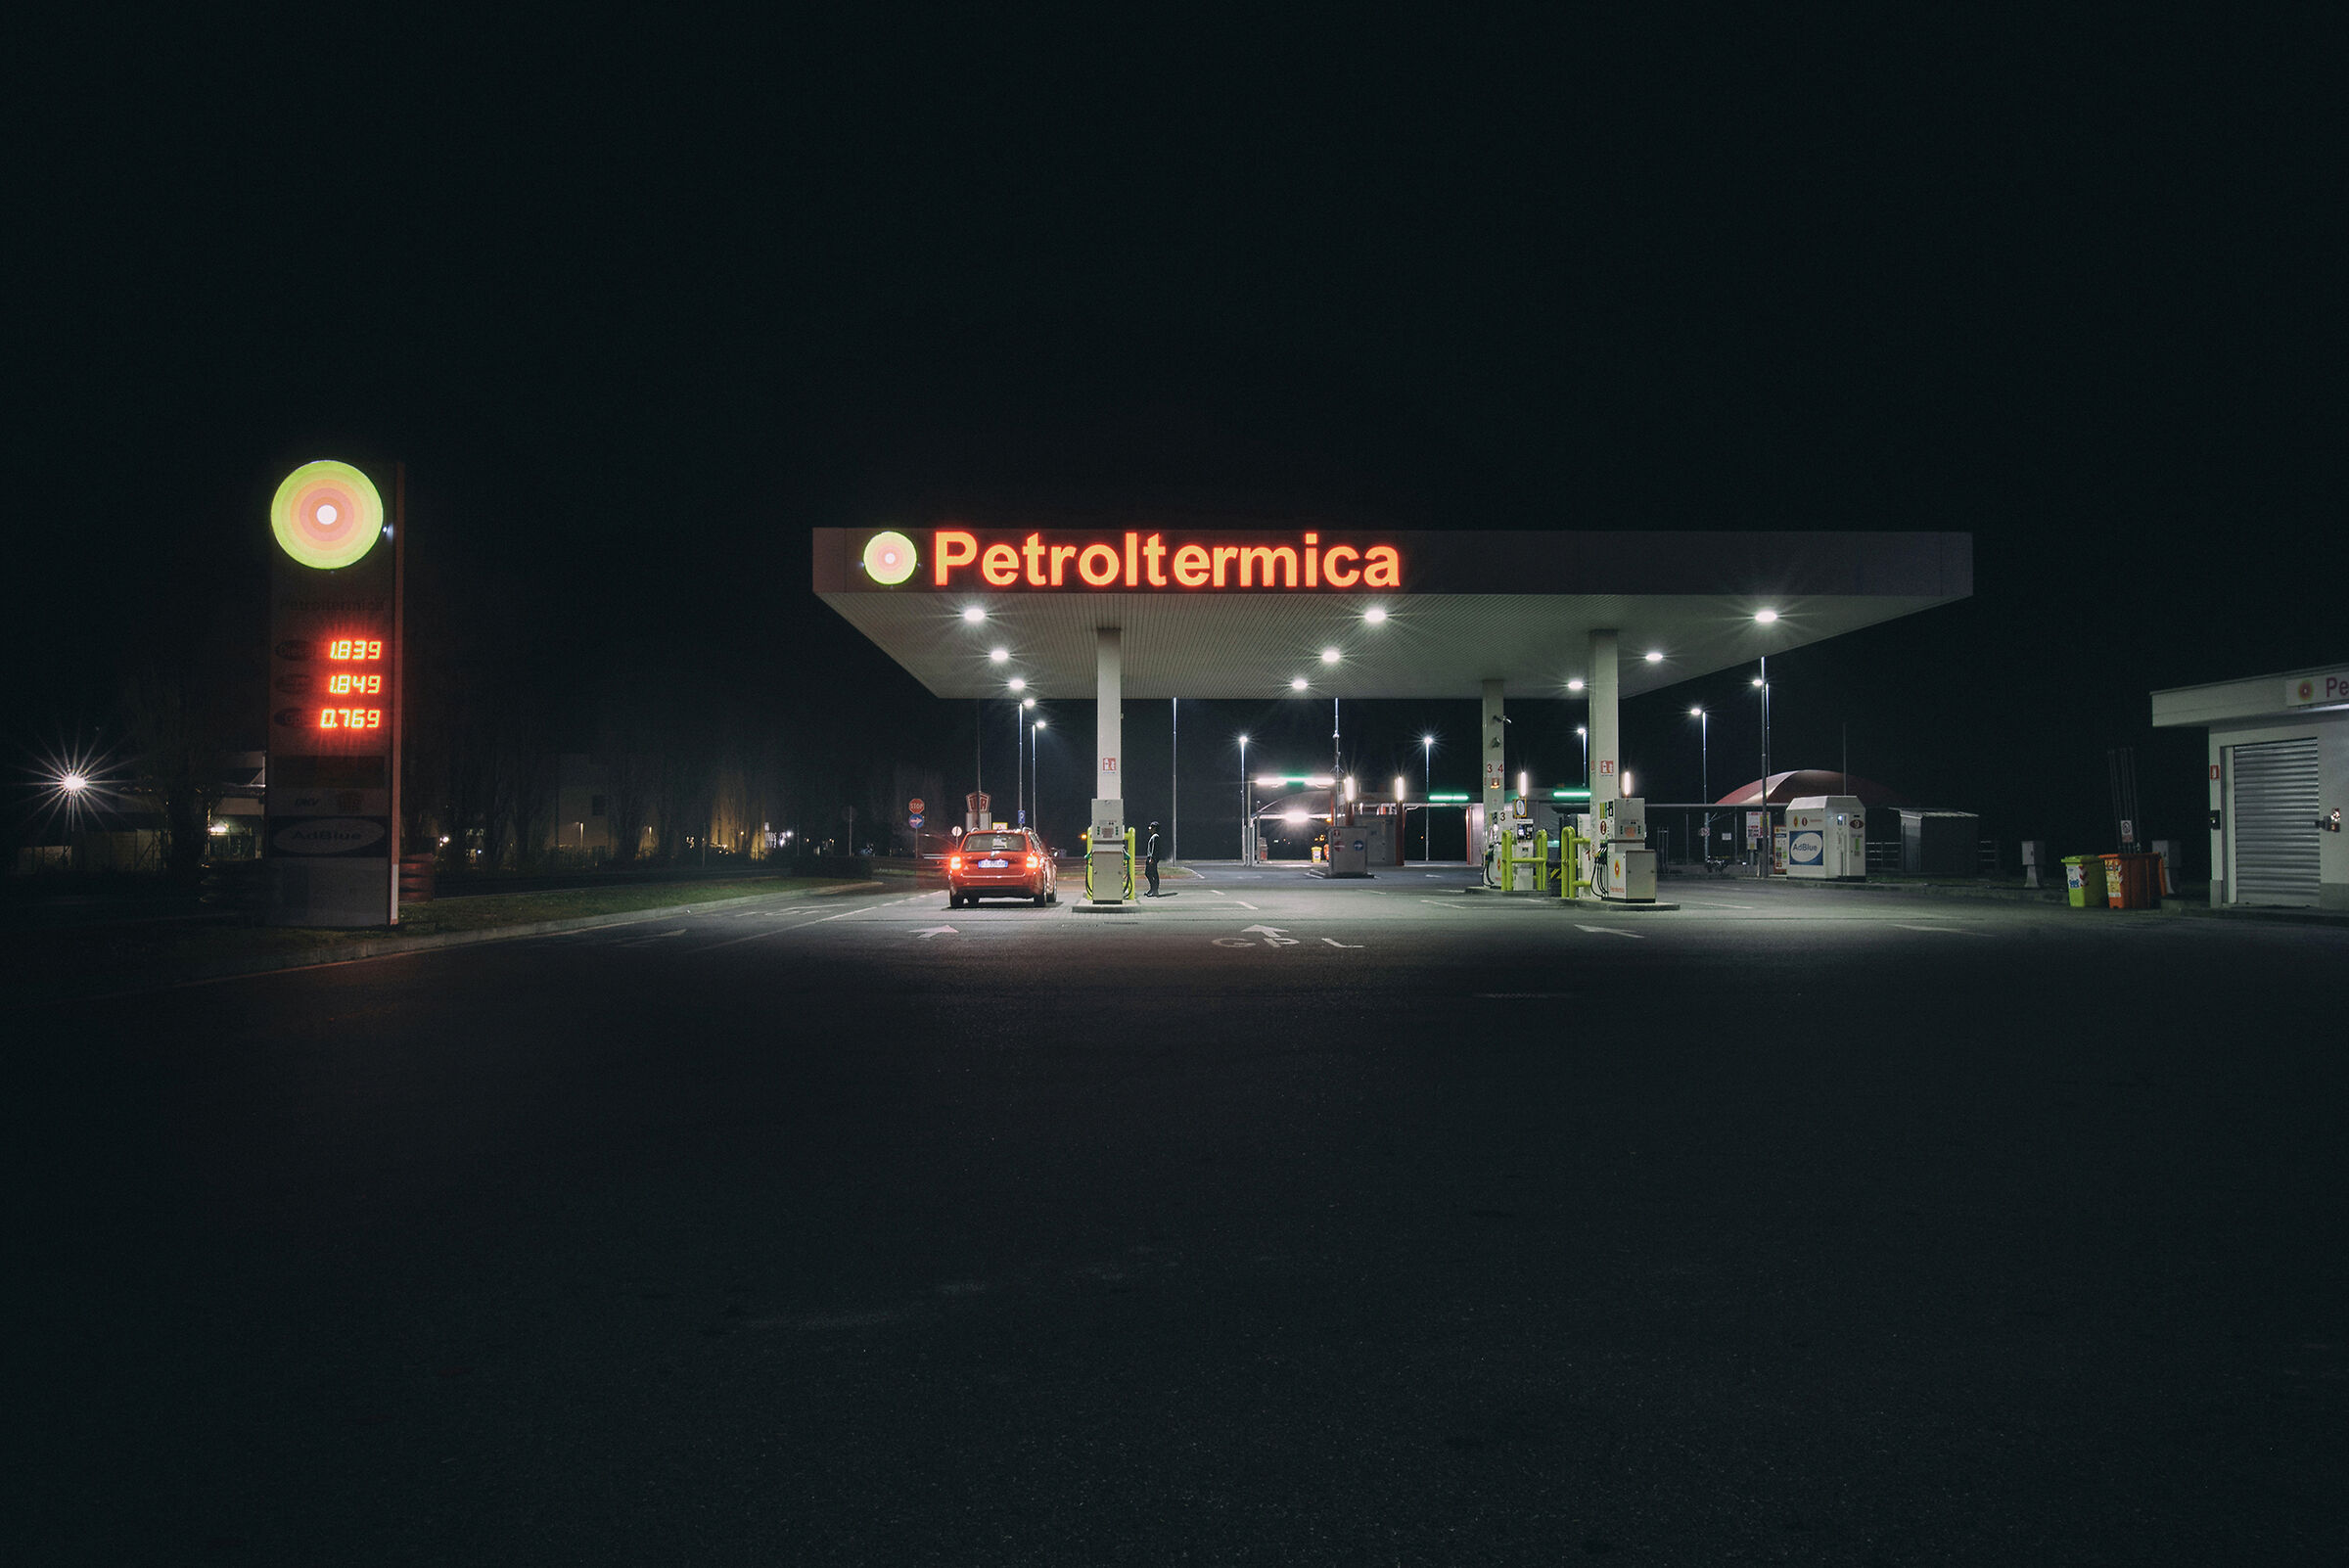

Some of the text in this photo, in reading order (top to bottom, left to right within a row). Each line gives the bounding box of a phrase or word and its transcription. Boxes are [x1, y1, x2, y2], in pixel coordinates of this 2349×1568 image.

[934, 530, 1401, 588] Petroltermica
[329, 640, 382, 660] 1.839
[329, 673, 382, 695] 1.849
[320, 708, 381, 729] 0.769
[1487, 763, 1504, 773] 3 4
[1499, 811, 1506, 822] 3
[291, 830, 361, 840] AdBlue
[1211, 937, 1364, 948] GPL
